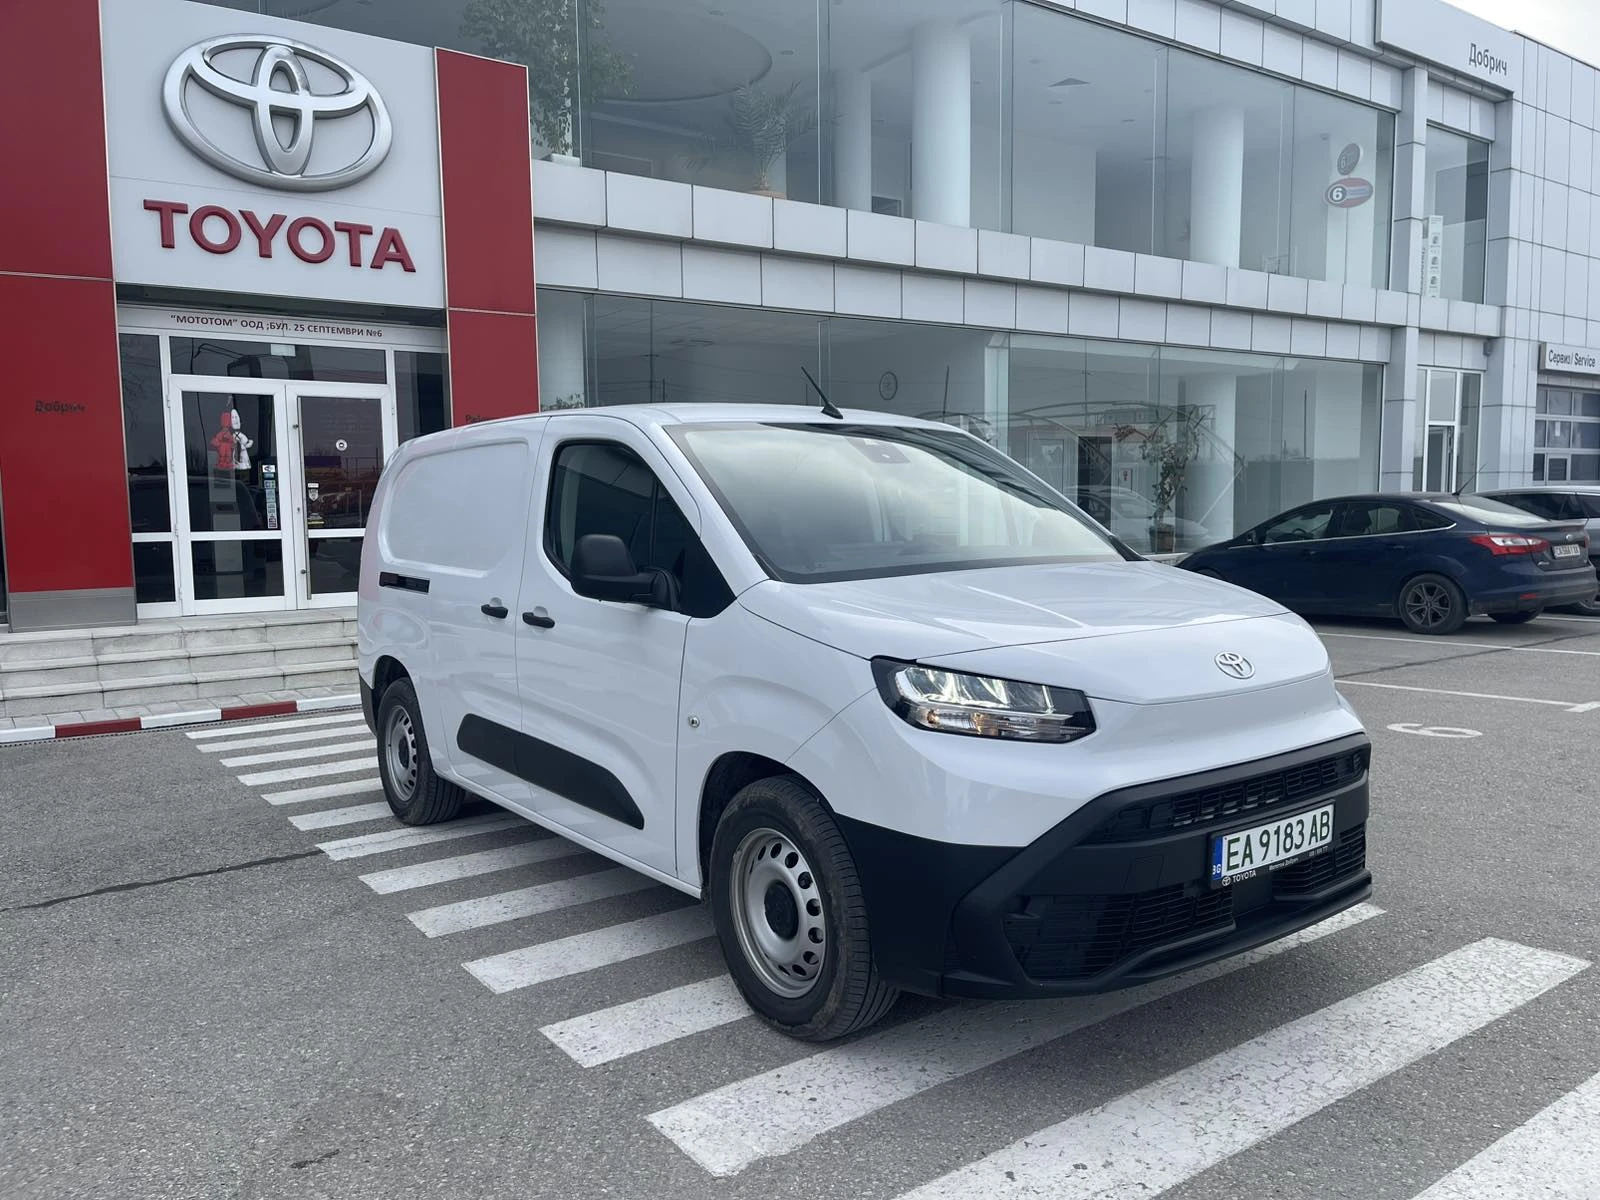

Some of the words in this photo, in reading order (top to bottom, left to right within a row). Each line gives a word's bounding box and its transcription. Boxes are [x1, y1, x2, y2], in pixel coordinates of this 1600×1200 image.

[1468, 42, 1508, 76] Добрич
[1331, 186, 1344, 202] 6
[143, 199, 416, 273] TOYOTA
[240, 319, 265, 331] ООД
[293, 323, 305, 332] 25
[307, 324, 364, 336] СЕПТЕМВРИ
[365, 328, 383, 338] №6
[1574, 352, 1596, 368] Service
[1226, 833, 1254, 872] EA
[1259, 818, 1305, 862] 9183
[1308, 810, 1331, 846] AB
[1232, 869, 1257, 883] TOYOTA
